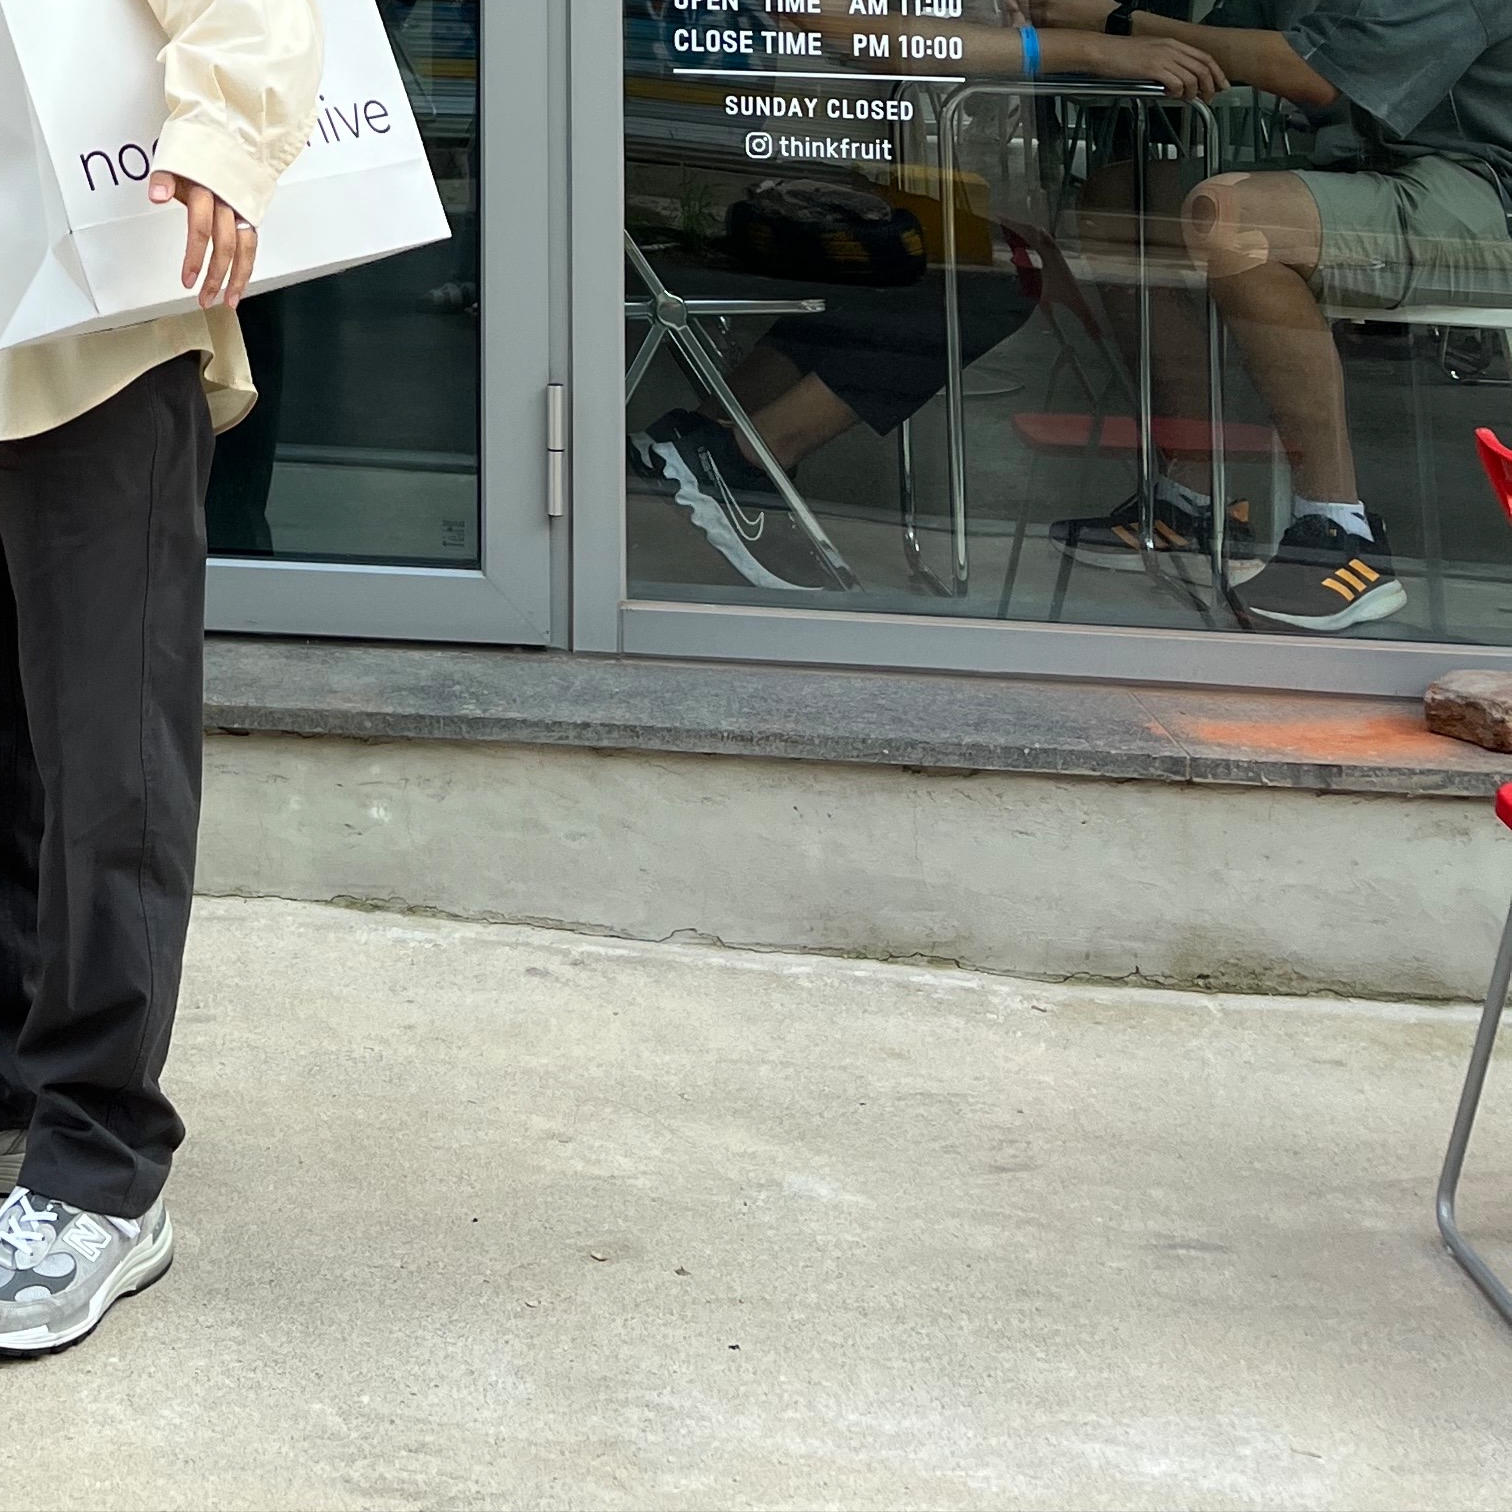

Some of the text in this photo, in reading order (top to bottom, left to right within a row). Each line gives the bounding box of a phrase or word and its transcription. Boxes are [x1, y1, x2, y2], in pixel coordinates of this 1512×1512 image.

[674, 29, 964, 60] CLOSE TIME PM 10:00
[725, 95, 915, 122] SUNDAY CLOSED
[778, 135, 893, 161] thinkfruit
